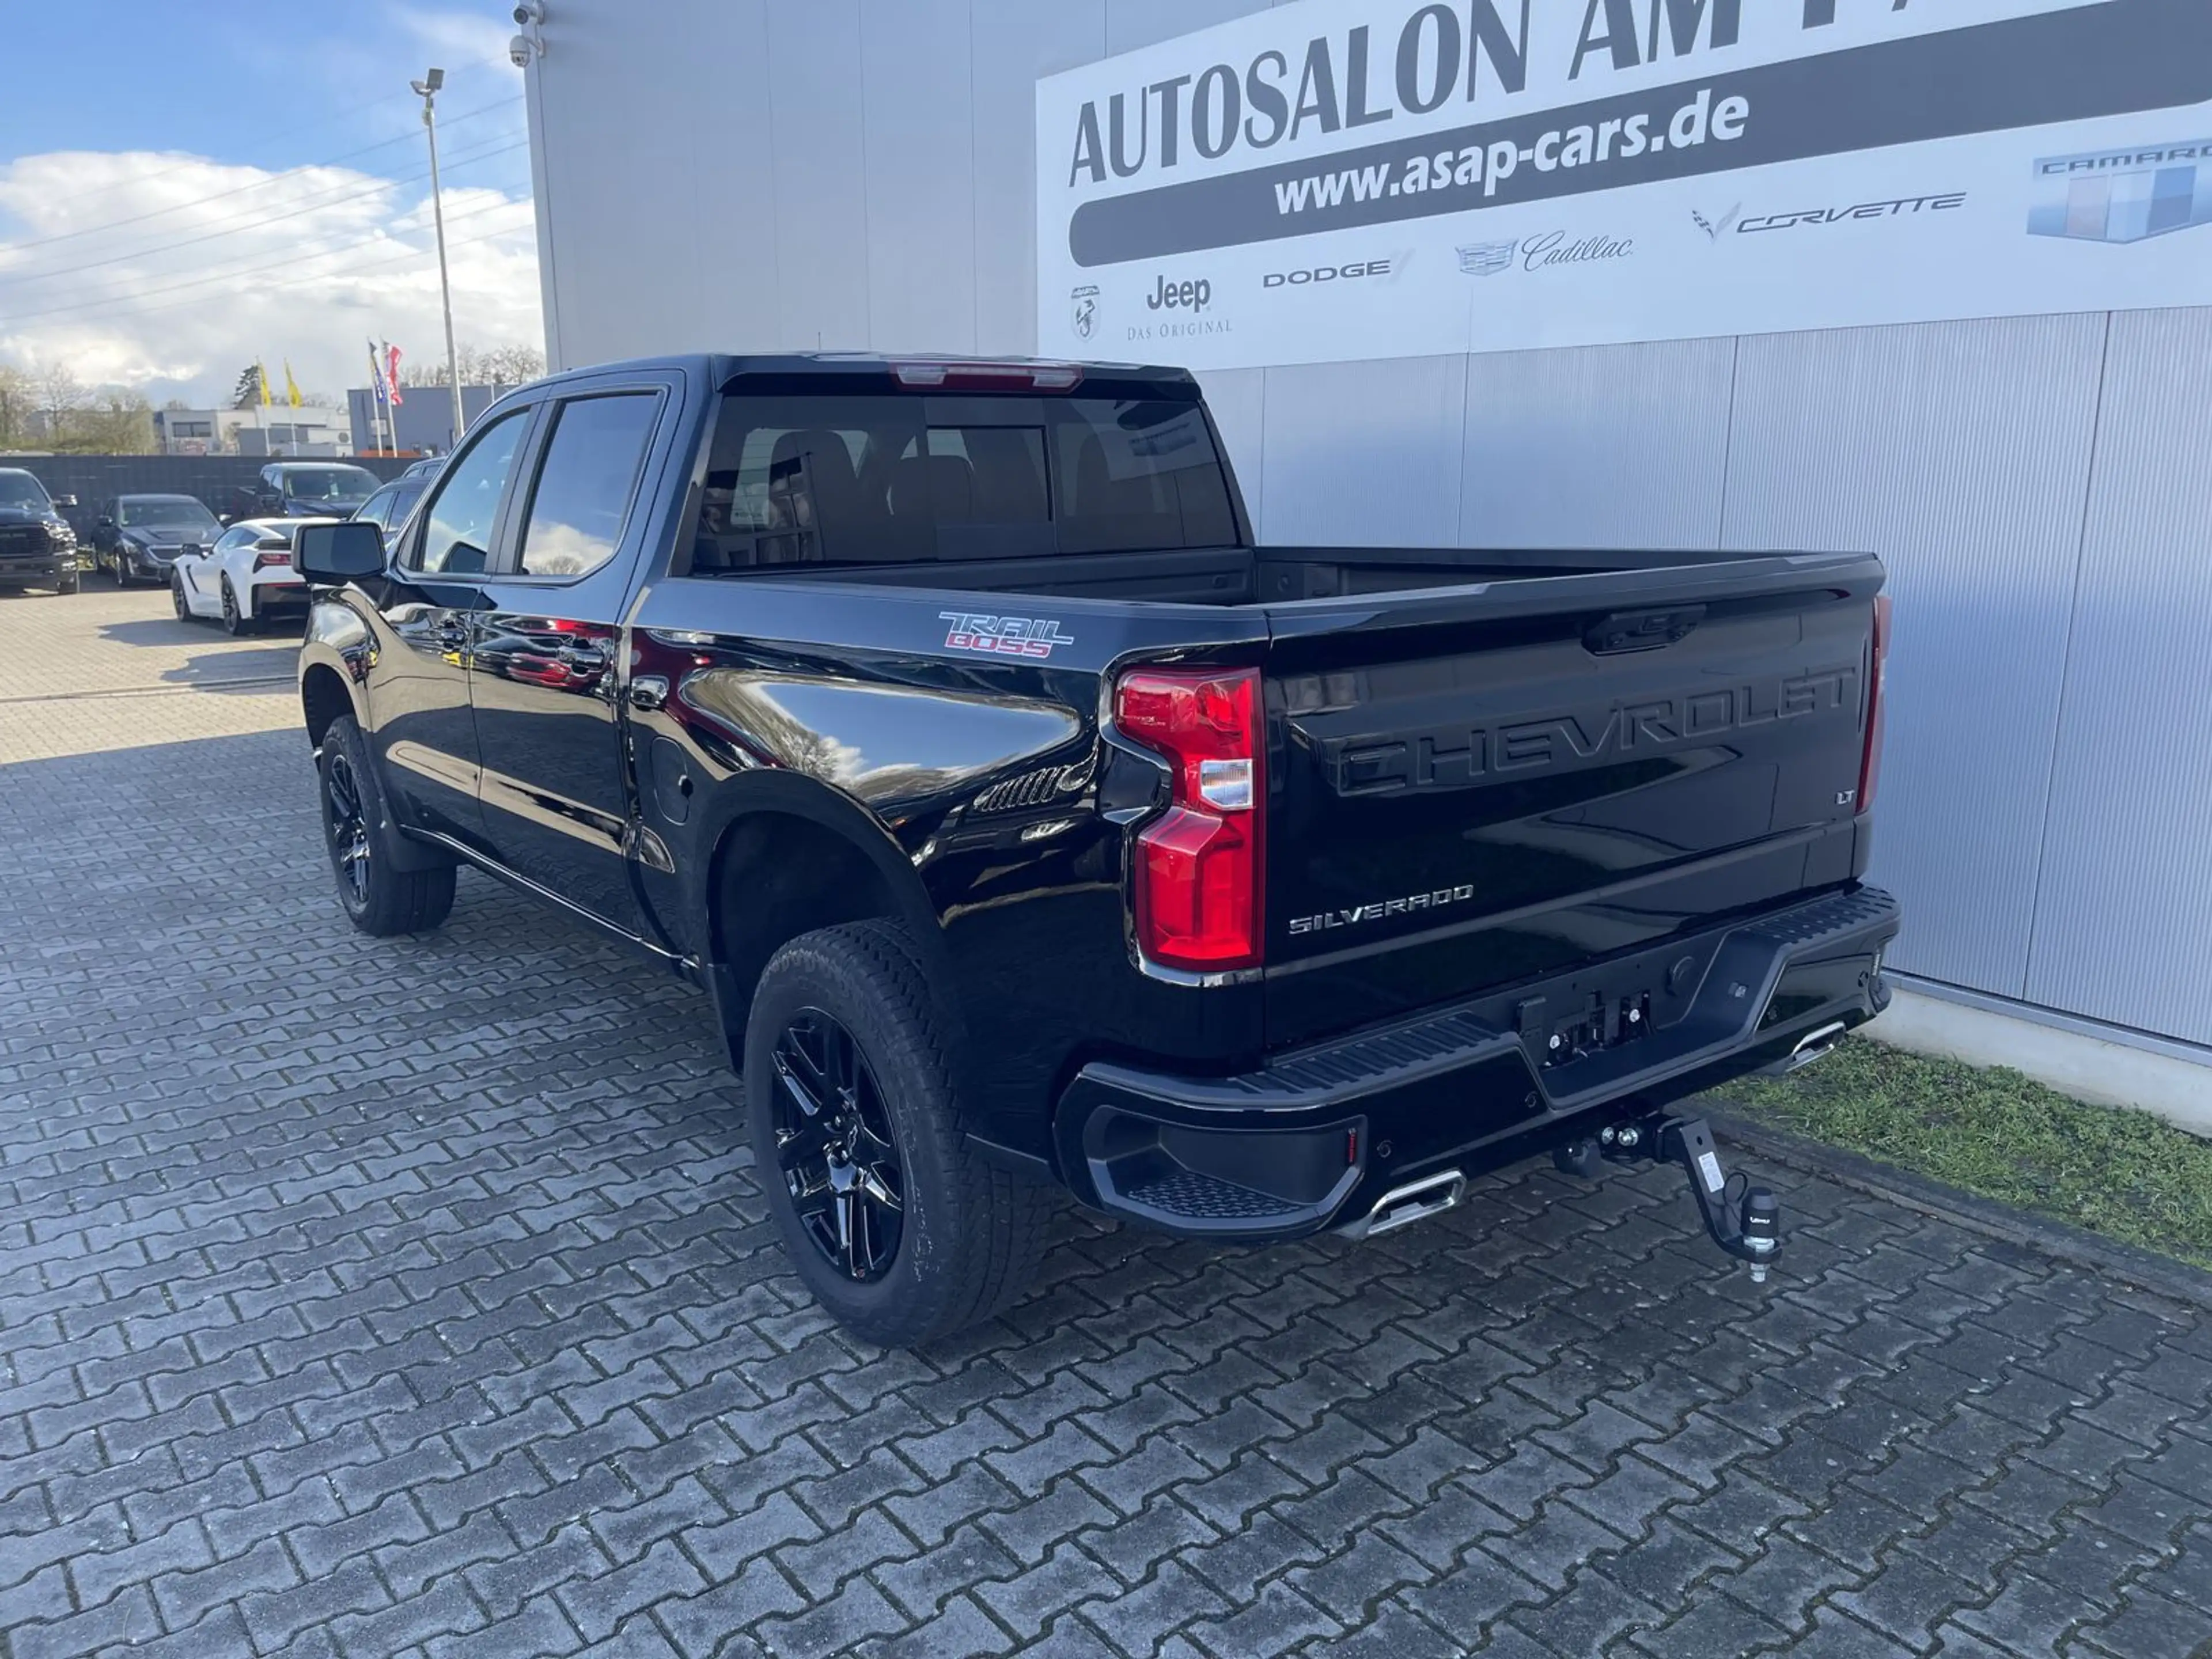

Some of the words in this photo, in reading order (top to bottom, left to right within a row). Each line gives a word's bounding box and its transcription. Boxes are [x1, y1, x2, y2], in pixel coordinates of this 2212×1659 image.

[1069, 0, 1530, 187] AUTOSALON
[1274, 89, 1749, 214] www.asap-cars.de
[1736, 192, 1967, 233] CORVETTE
[1521, 230, 1634, 272] Cadillac
[1147, 275, 1211, 313] Jeep
[1263, 260, 1391, 288] DODGE
[938, 611, 1074, 645] TRAIL
[944, 632, 1052, 658] BOSS
[1338, 666, 1855, 797] CHEVROLET
[1836, 789, 1855, 804] LT
[1289, 884, 1474, 934] SILVERADO
